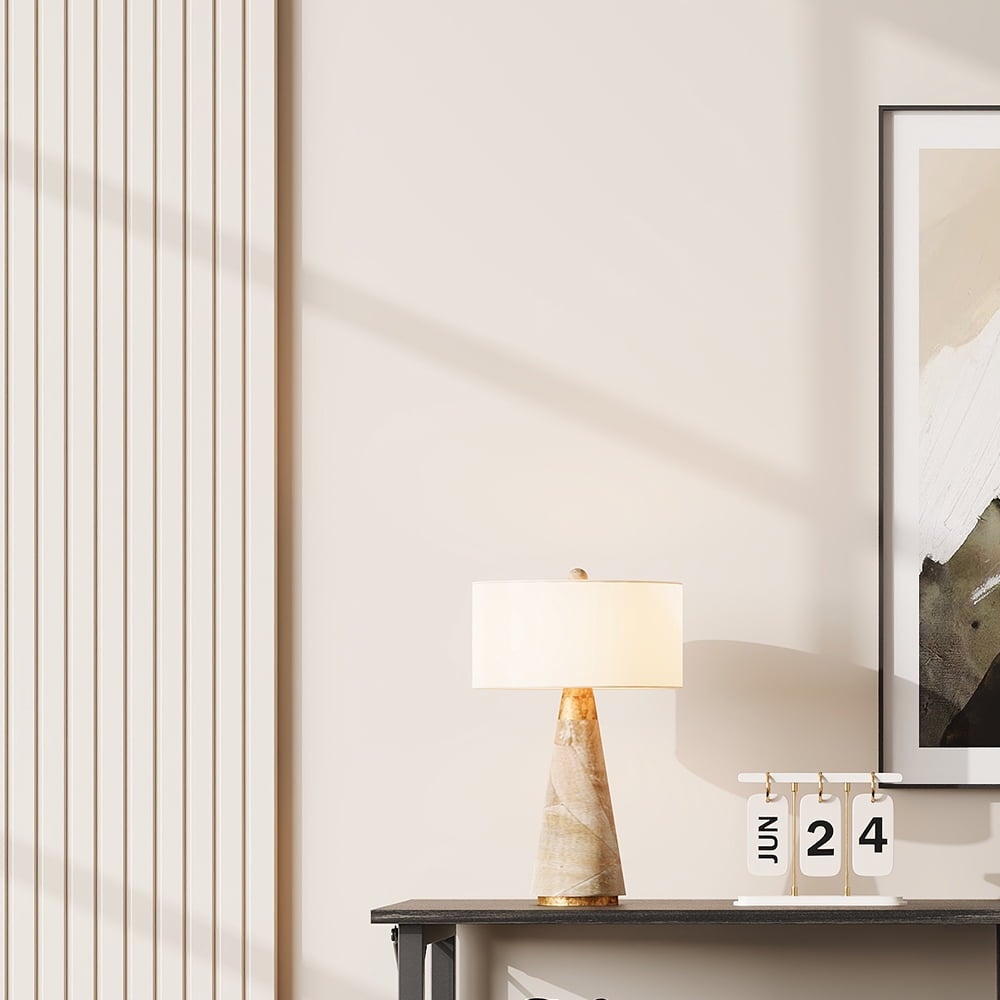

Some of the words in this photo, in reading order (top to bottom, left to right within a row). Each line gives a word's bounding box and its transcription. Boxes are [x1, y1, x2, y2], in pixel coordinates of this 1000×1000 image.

[758, 816, 778, 864] JUN
[807, 819, 835, 857] 2
[858, 816, 888, 854] 4
